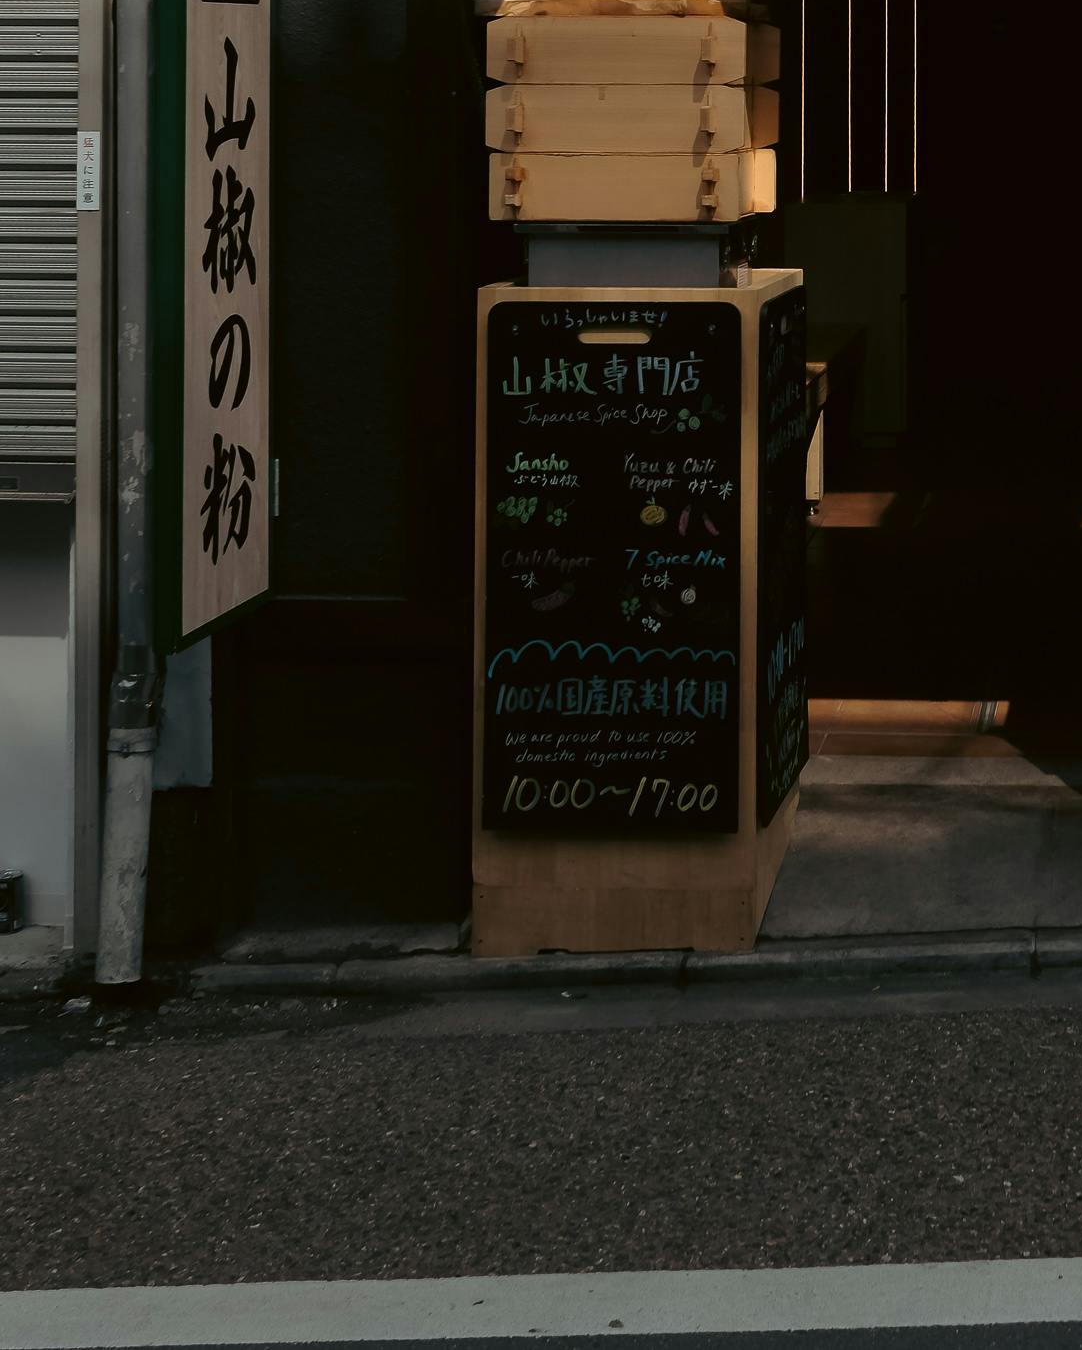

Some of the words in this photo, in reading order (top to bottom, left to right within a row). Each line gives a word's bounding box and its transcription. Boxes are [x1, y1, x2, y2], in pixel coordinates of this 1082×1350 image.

[201, 36, 258, 567] 山椒の粉
[502, 351, 704, 395] 山椒専門店
[519, 402, 591, 427] Japanese
[593, 403, 628, 426] Spice
[630, 403, 669, 426] Shop
[623, 452, 660, 474] Yuzu
[682, 458, 716, 473] Chili
[629, 475, 680, 493] Pepper
[501, 549, 543, 569] Chili
[544, 548, 597, 573] Pepper
[625, 549, 639, 571] 7
[646, 550, 690, 570] Spice
[692, 549, 727, 568] Mix
[512, 570, 540, 589] 一味
[641, 570, 675, 589] 七味
[496, 675, 728, 720] 100%国産原料使用
[505, 730, 528, 746] We
[531, 733, 552, 743] are
[556, 729, 602, 749] proud
[627, 733, 649, 743] use
[656, 730, 696, 746] 100%
[515, 748, 576, 763] domestic
[584, 748, 669, 768] ingredients
